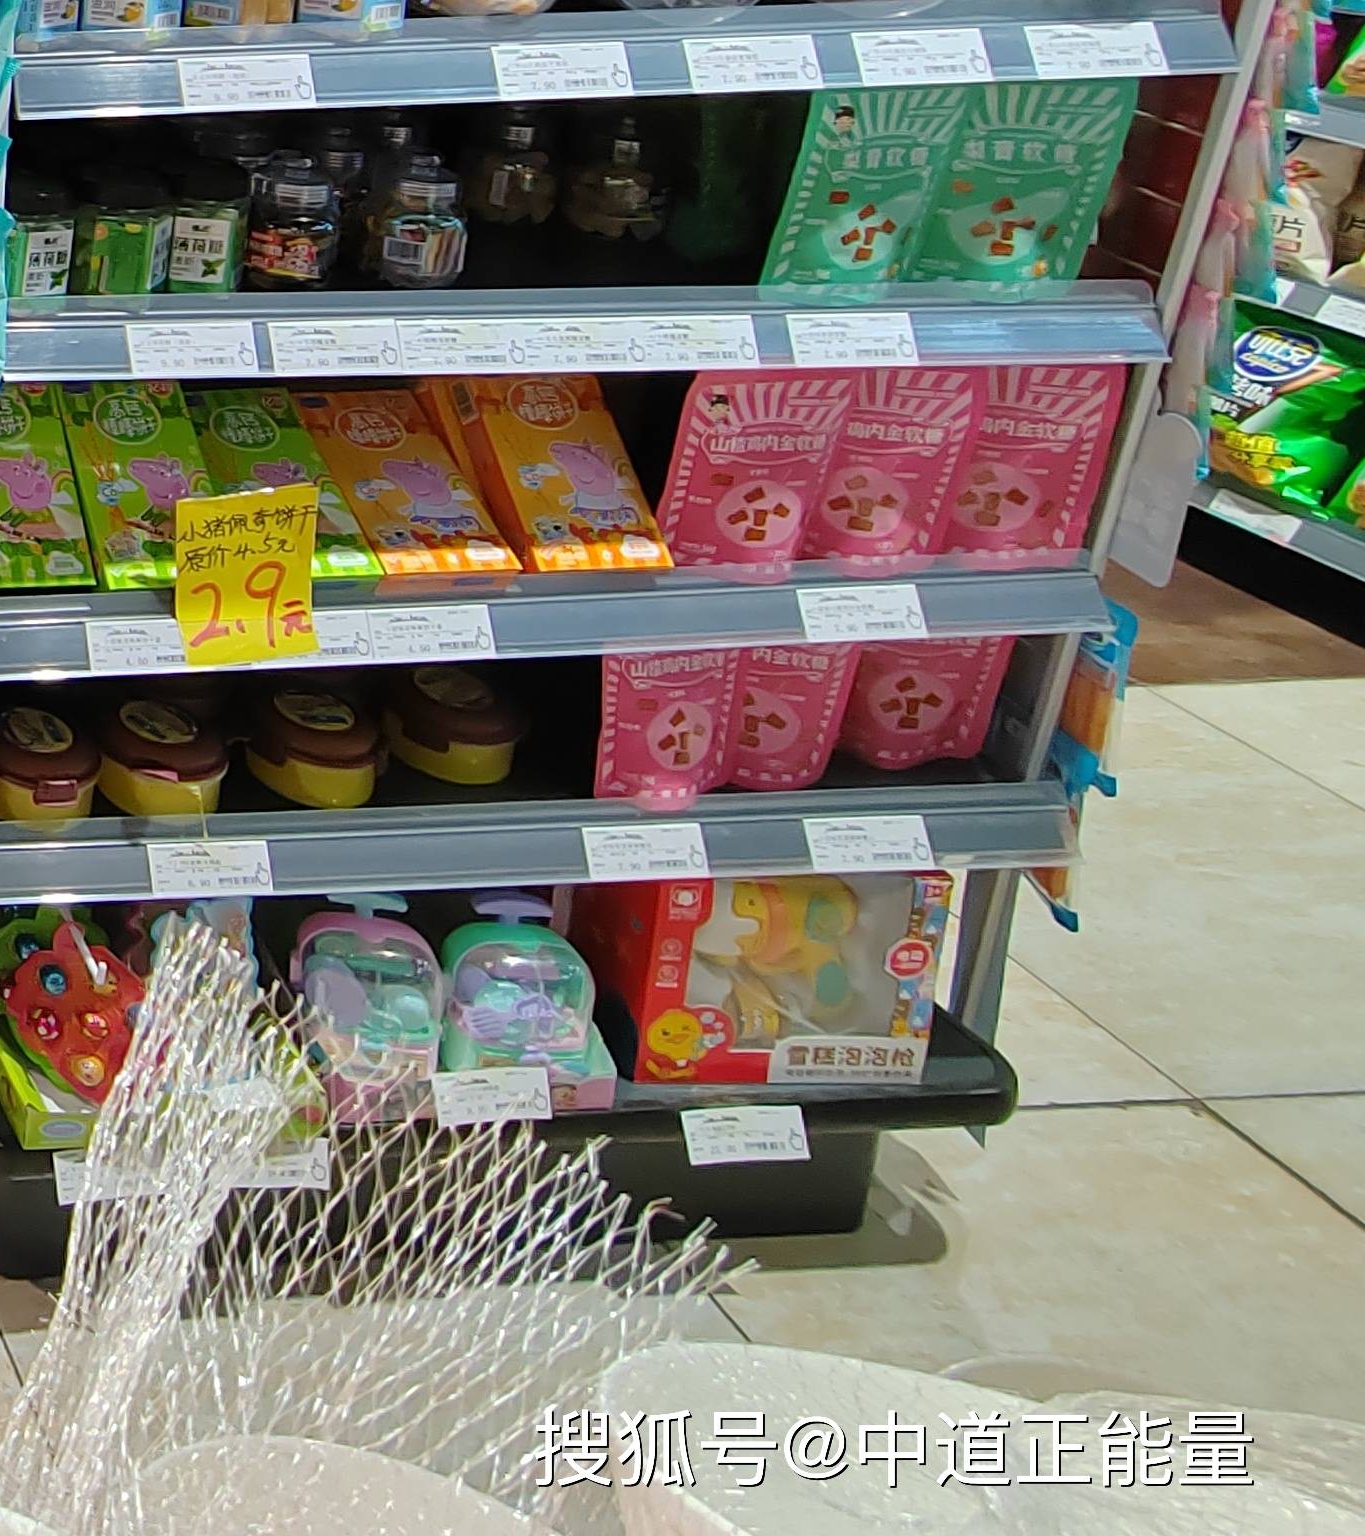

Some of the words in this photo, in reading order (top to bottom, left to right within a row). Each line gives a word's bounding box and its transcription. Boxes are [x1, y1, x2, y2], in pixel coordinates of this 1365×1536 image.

[175, 505, 319, 546] 小猪佩奇饼干
[189, 560, 314, 649] 2.9元
